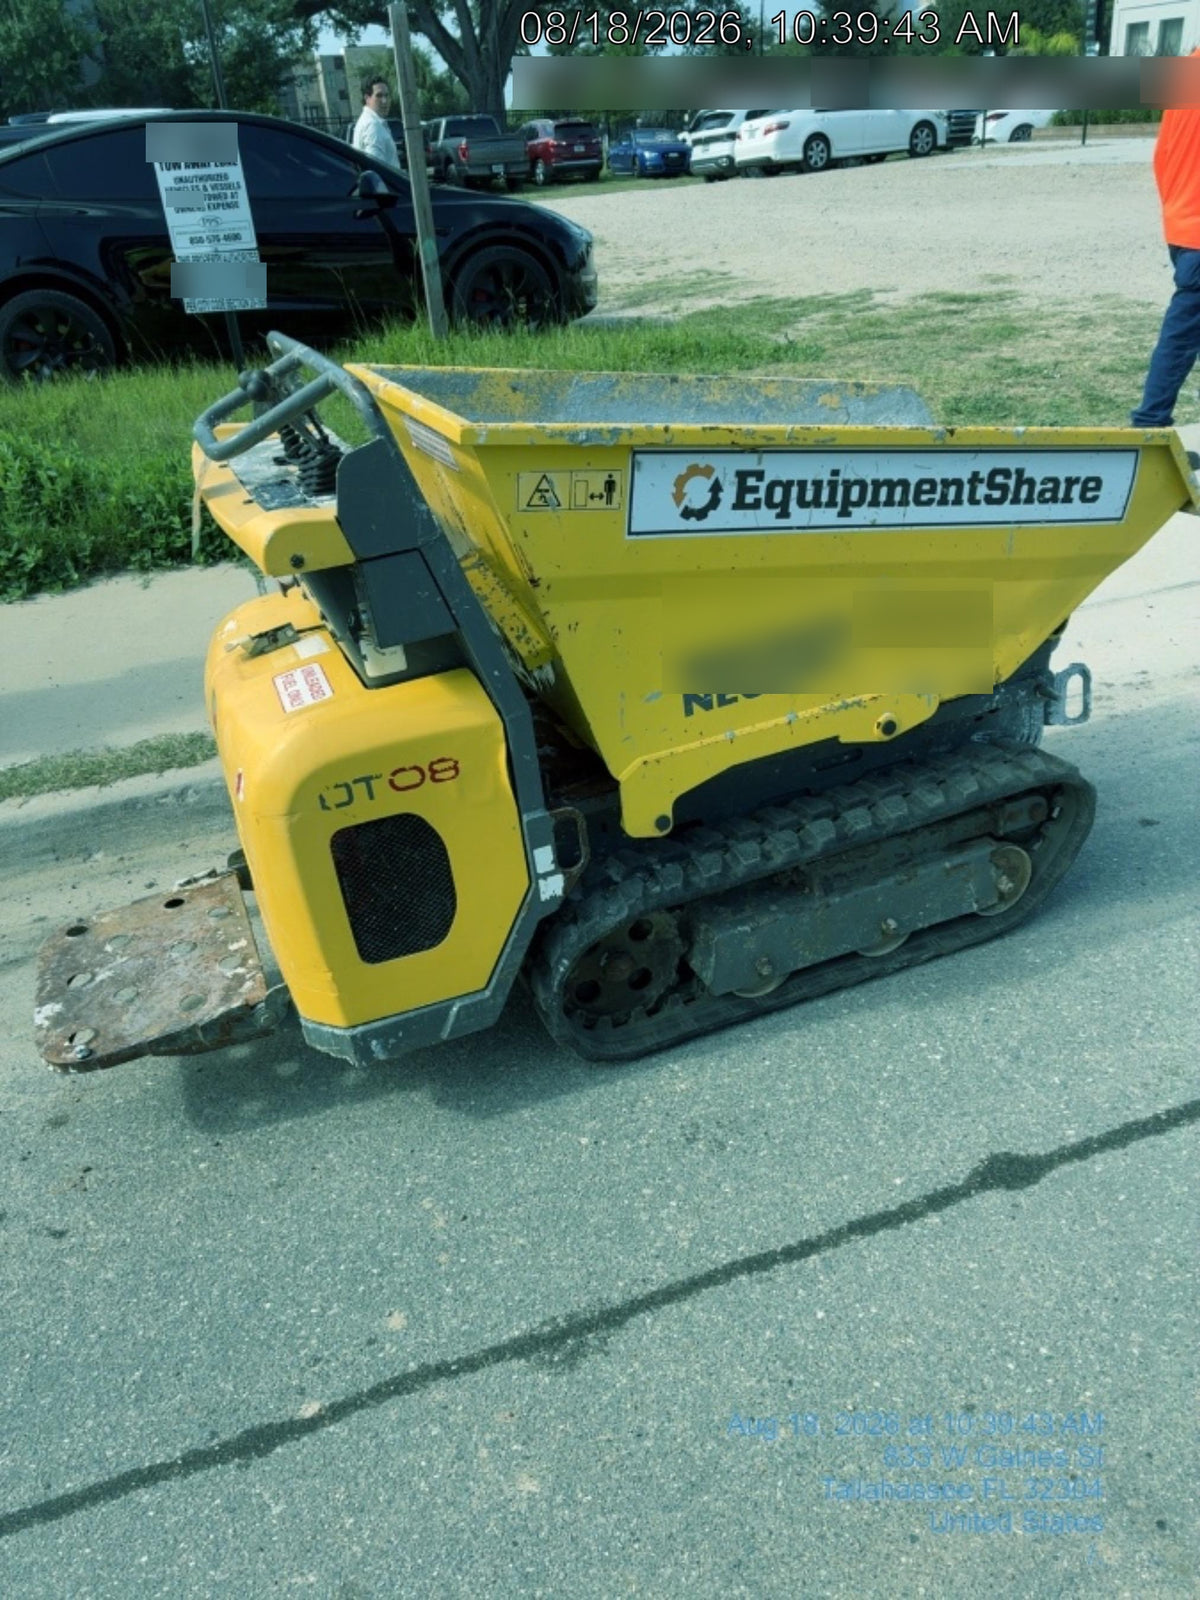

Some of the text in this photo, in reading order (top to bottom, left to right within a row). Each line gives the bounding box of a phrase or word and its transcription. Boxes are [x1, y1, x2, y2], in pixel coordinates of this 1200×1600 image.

[173, 172, 229, 185] UNAUTHORIZED
[209, 181, 241, 191] VESSELS
[203, 191, 239, 201] TOWED AT
[207, 201, 240, 211] EXPENSE
[730, 466, 1103, 519] EquipmentShare
